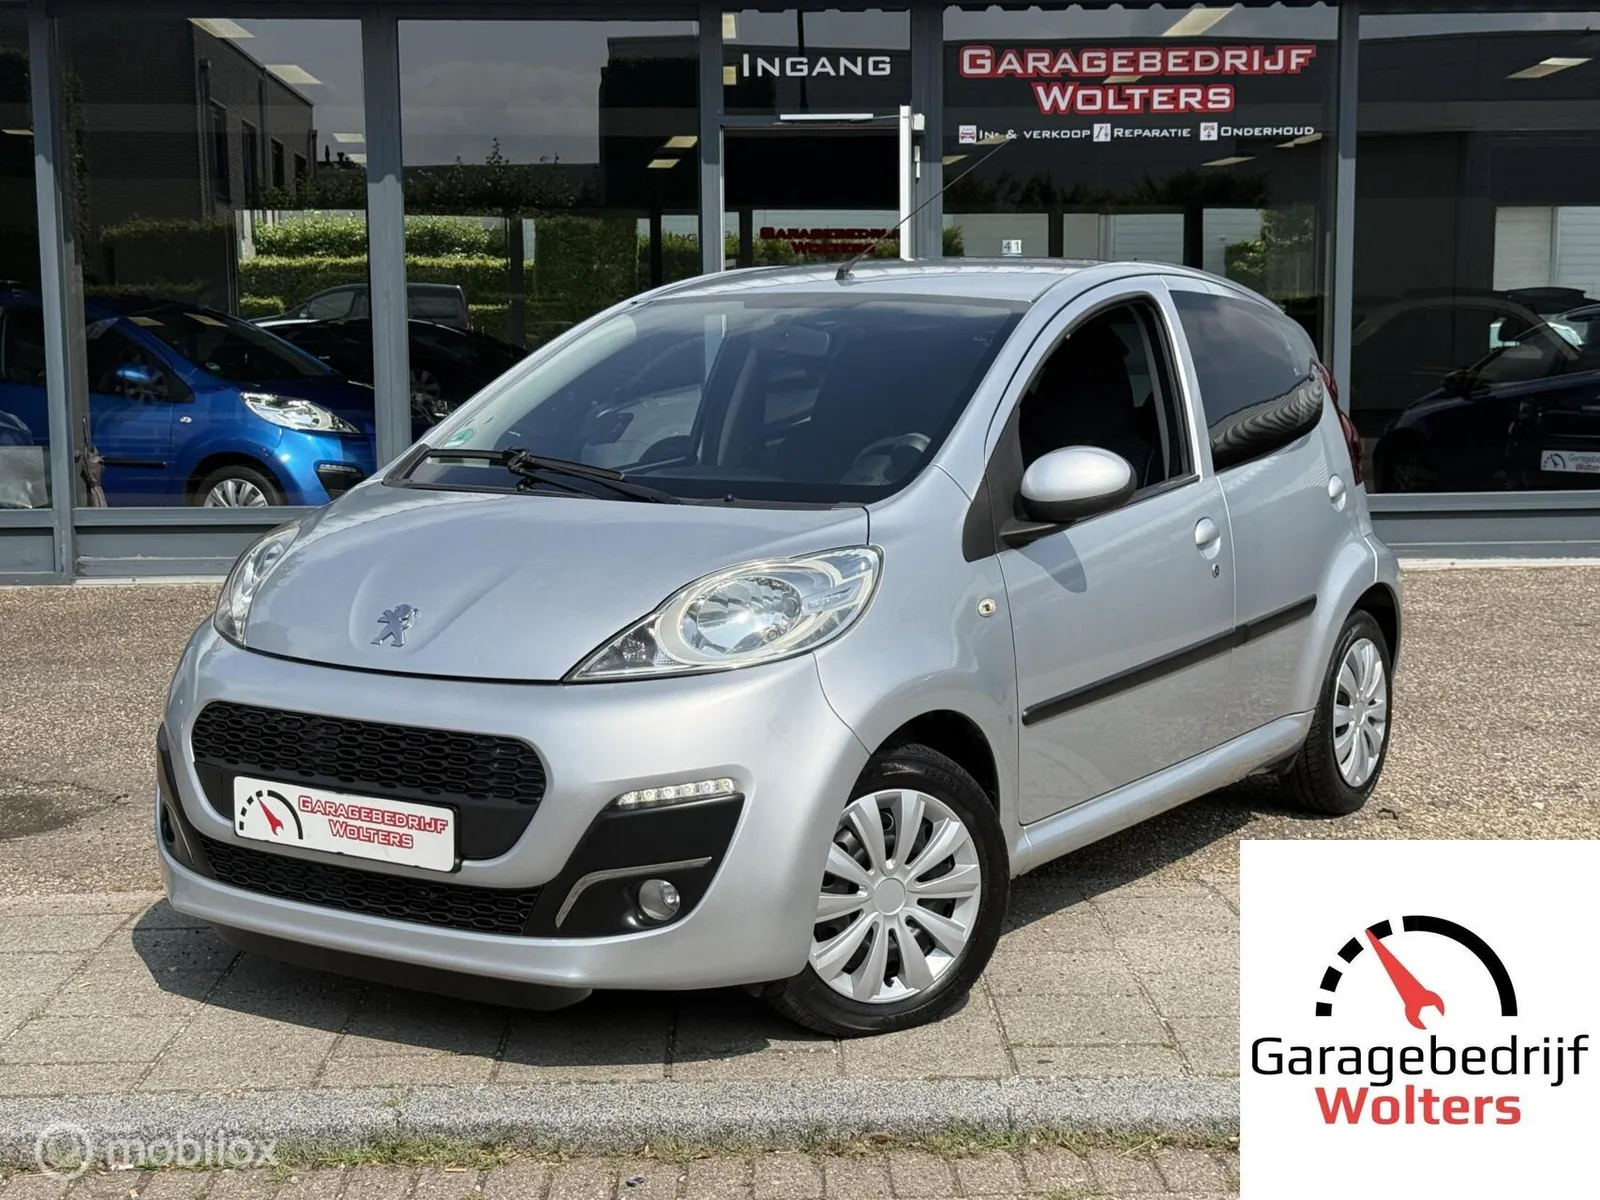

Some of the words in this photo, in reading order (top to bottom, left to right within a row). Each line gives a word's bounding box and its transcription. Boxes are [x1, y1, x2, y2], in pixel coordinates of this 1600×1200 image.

[743, 53, 891, 77] INGANG
[960, 45, 1316, 76] GARAGEBEDRIJF
[1032, 82, 1235, 114] WOLTERS
[1005, 129, 1017, 140] &
[1023, 130, 1091, 140] VERKOOP
[1113, 127, 1192, 138] REPARATIE
[1220, 126, 1315, 137] ONDERHOUD
[1003, 241, 1020, 252] 41
[298, 795, 449, 834] GARAGEBEDRIJF
[328, 819, 414, 849] WOLTERS
